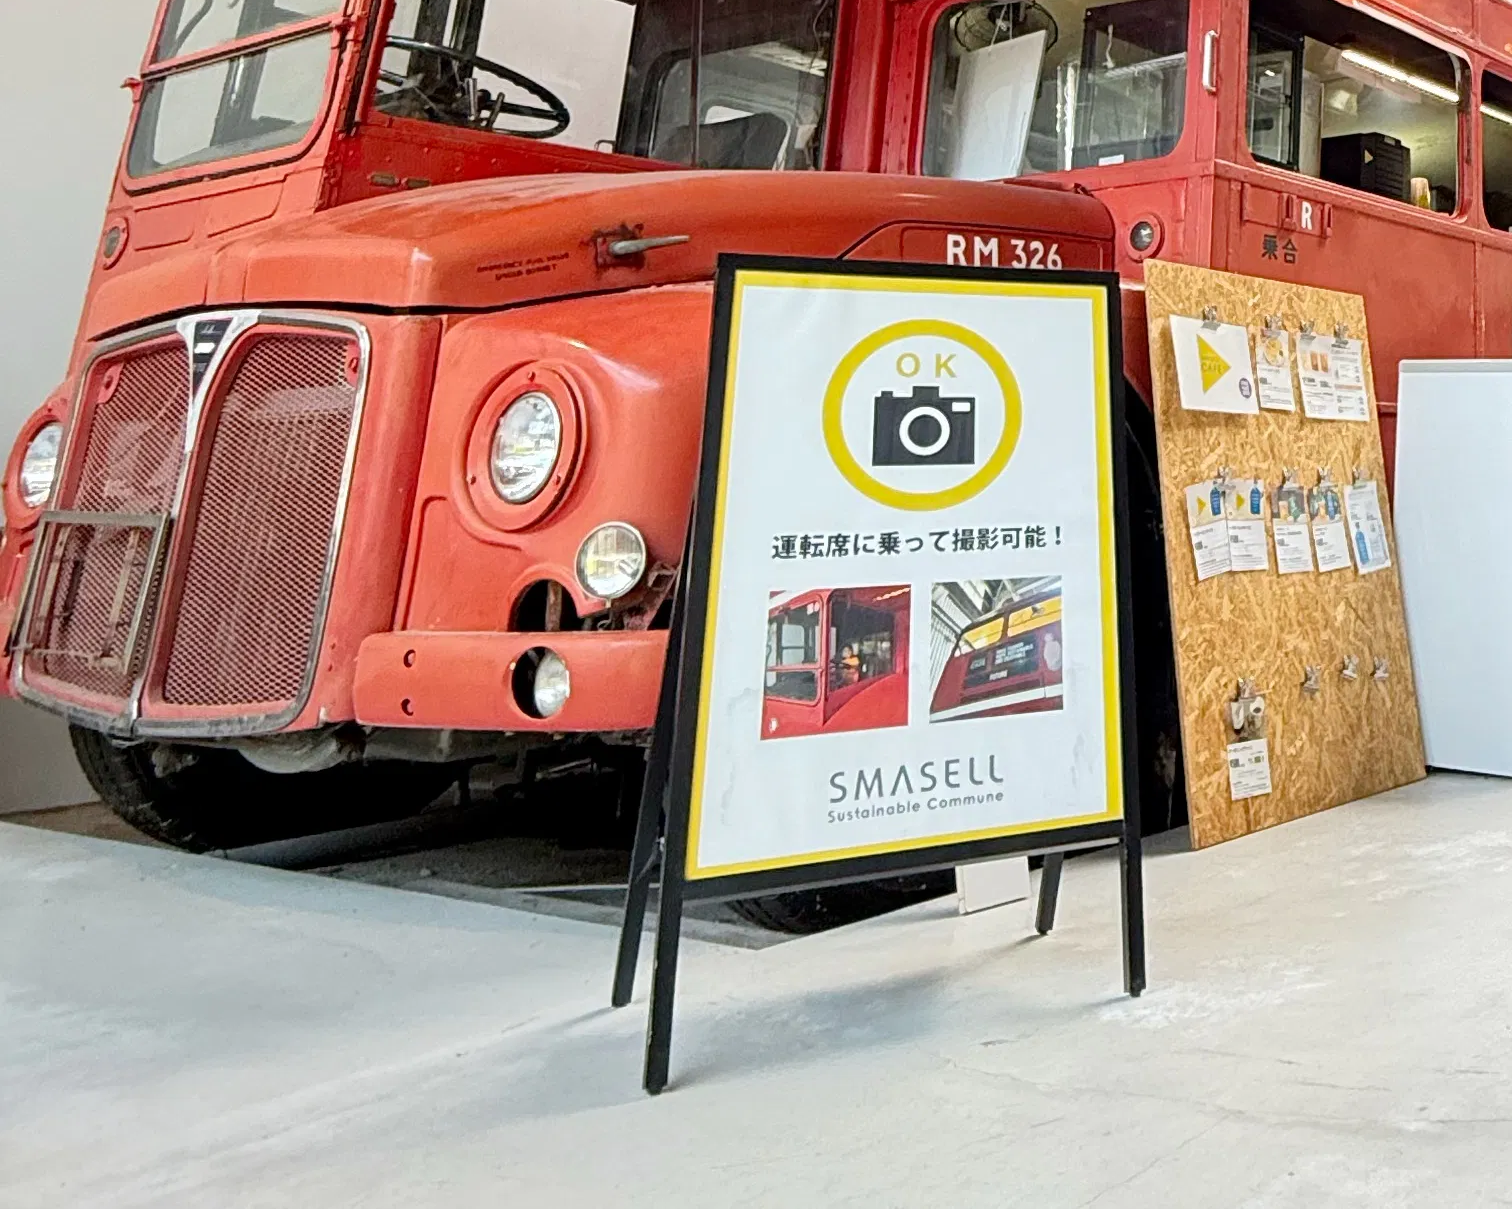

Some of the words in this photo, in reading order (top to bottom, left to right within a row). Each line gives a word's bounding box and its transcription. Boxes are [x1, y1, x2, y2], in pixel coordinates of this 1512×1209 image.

[1301, 200, 1313, 230] R
[946, 233, 999, 268] RM
[1010, 238, 1063, 270] 326
[895, 352, 958, 380] OK
[771, 525, 1062, 560] 運転席に乗って撮影可能！
[829, 754, 1005, 804] SMASELL
[827, 800, 921, 824] Sustainable
[926, 791, 1005, 811] Commune
